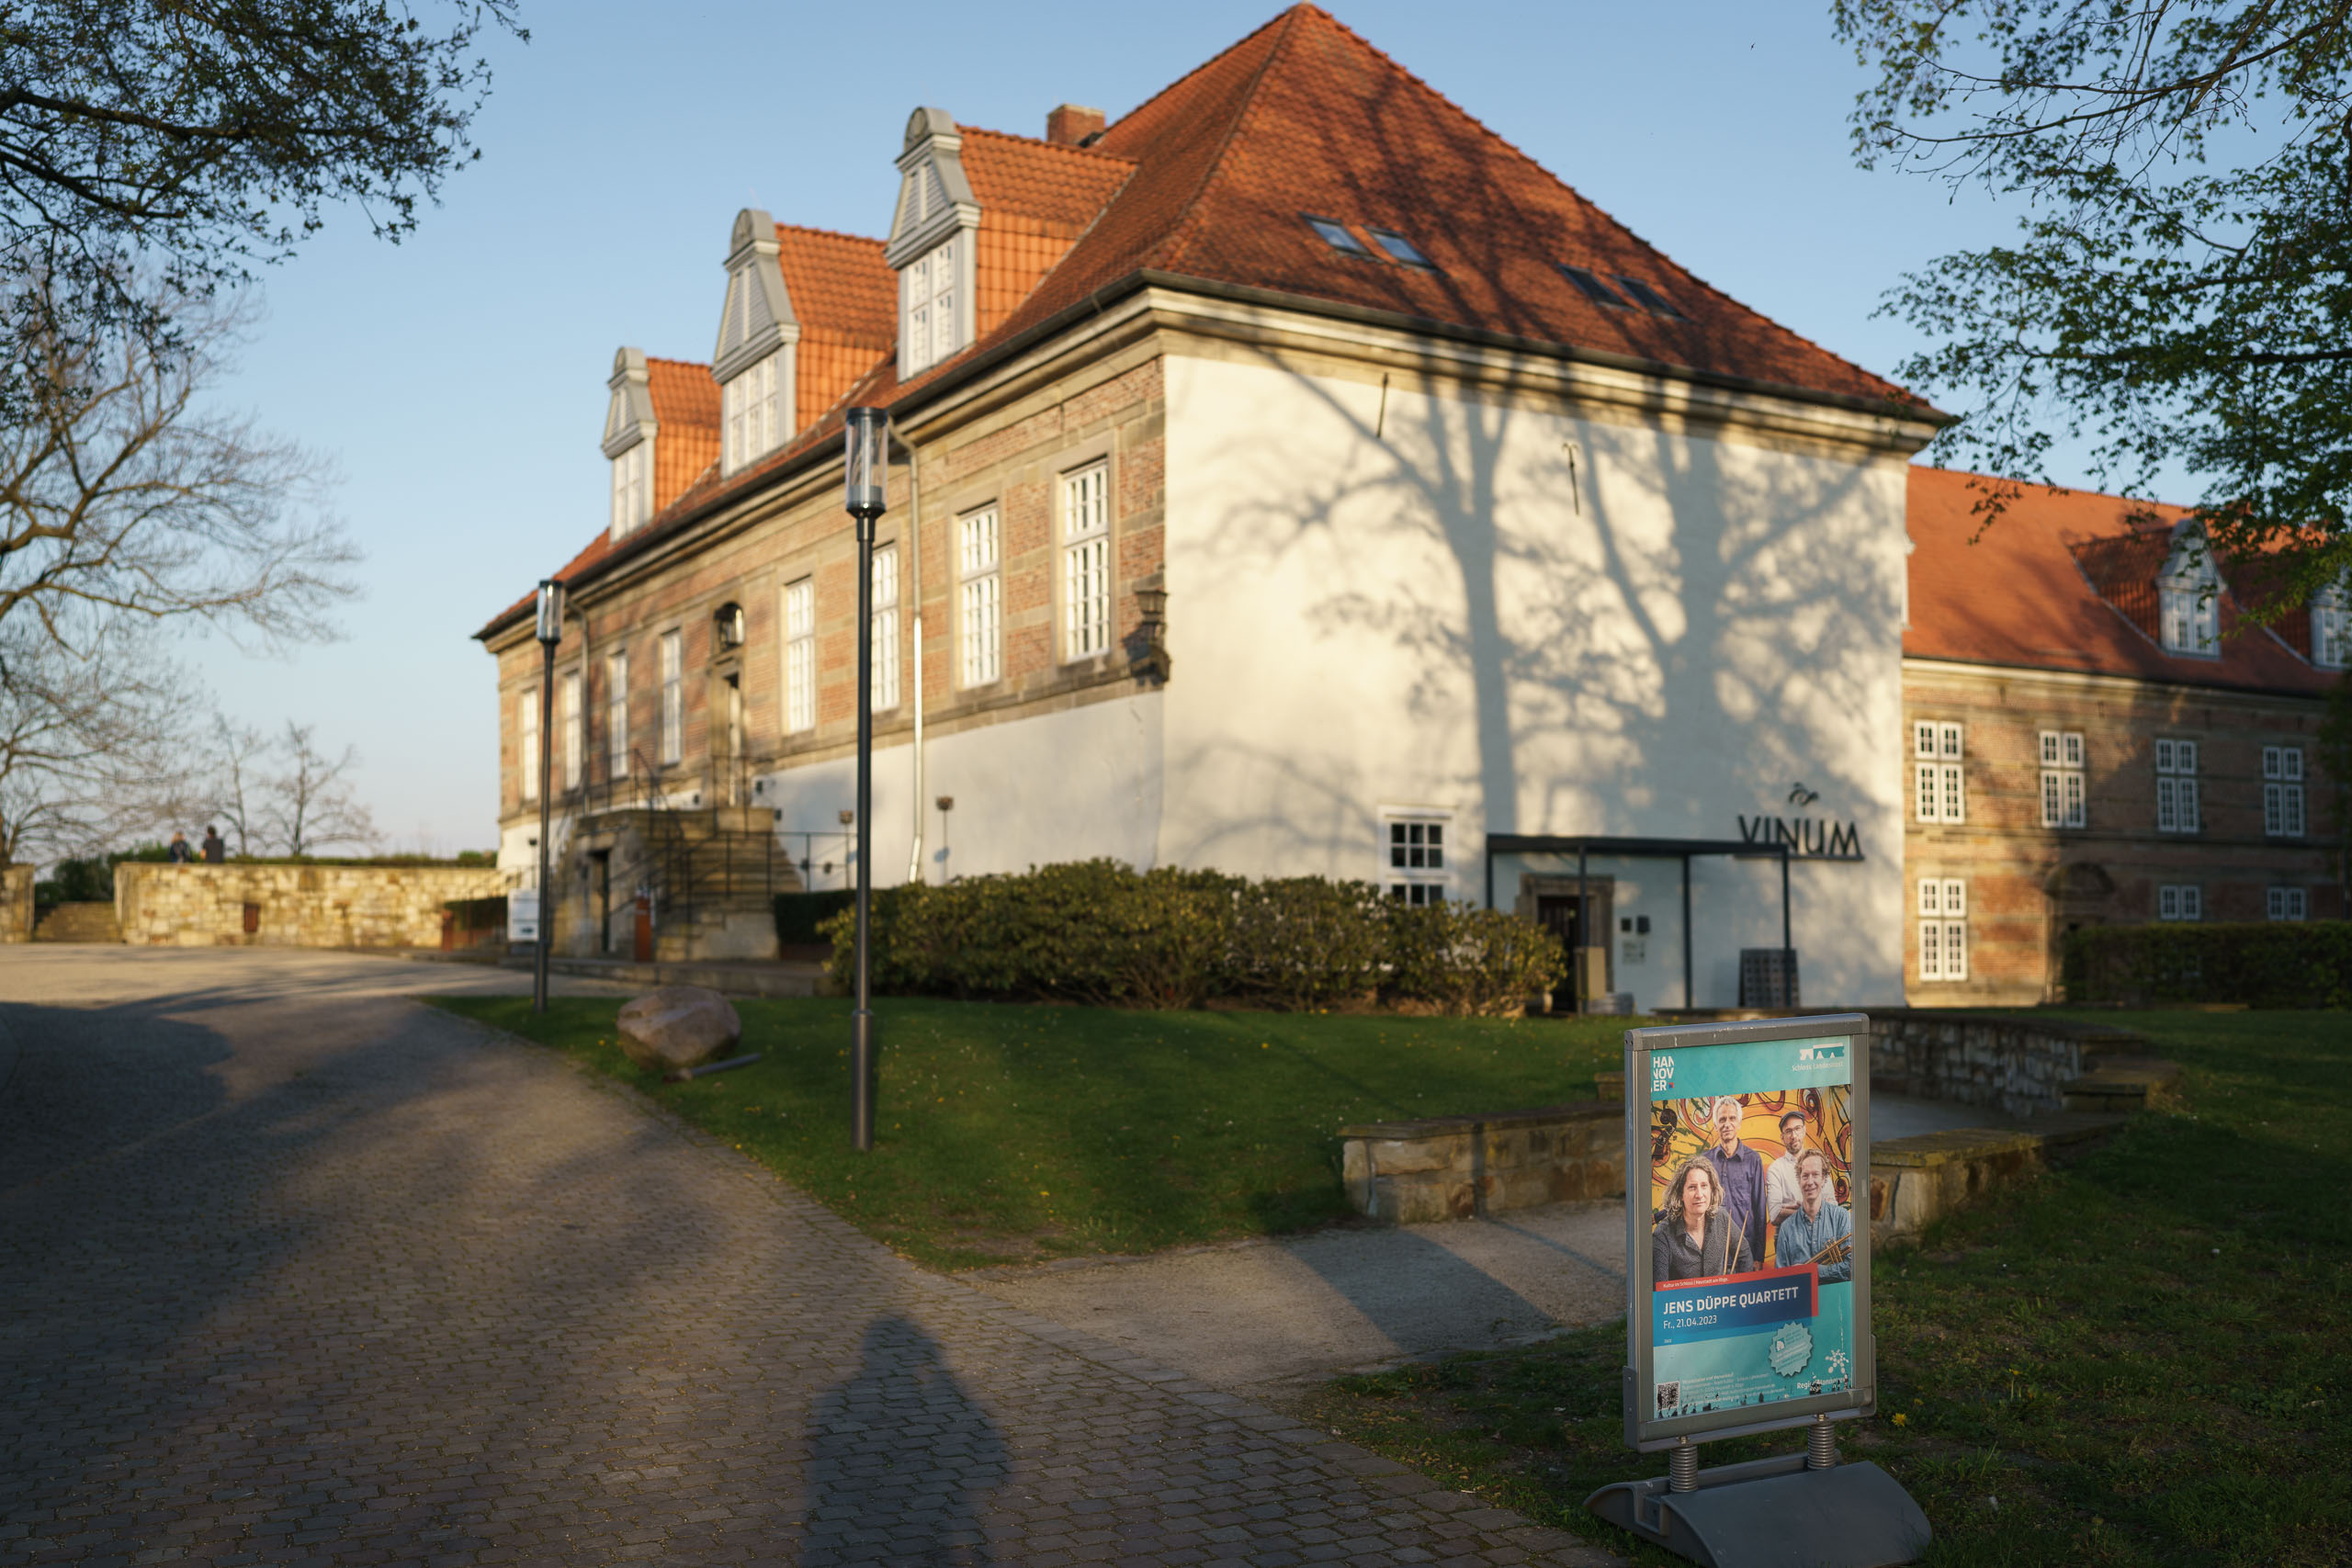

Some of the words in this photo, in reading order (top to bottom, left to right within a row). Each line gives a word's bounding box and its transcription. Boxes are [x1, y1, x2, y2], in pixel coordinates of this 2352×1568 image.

[1738, 814, 1861, 855] VINUM
[1653, 1055, 1675, 1067] HAN
[1792, 1063, 1812, 1071] Schloss
[1653, 1067, 1675, 1079] NOV
[1653, 1080, 1668, 1092] ER
[1663, 1300, 1693, 1315] JENS
[1697, 1295, 1736, 1312] DÜPPE
[1739, 1286, 1799, 1308] QUARTETT
[1663, 1320, 1675, 1330] Fr.,
[1676, 1314, 1717, 1328] 21.04.2023
[1796, 1380, 1815, 1389] Regi
